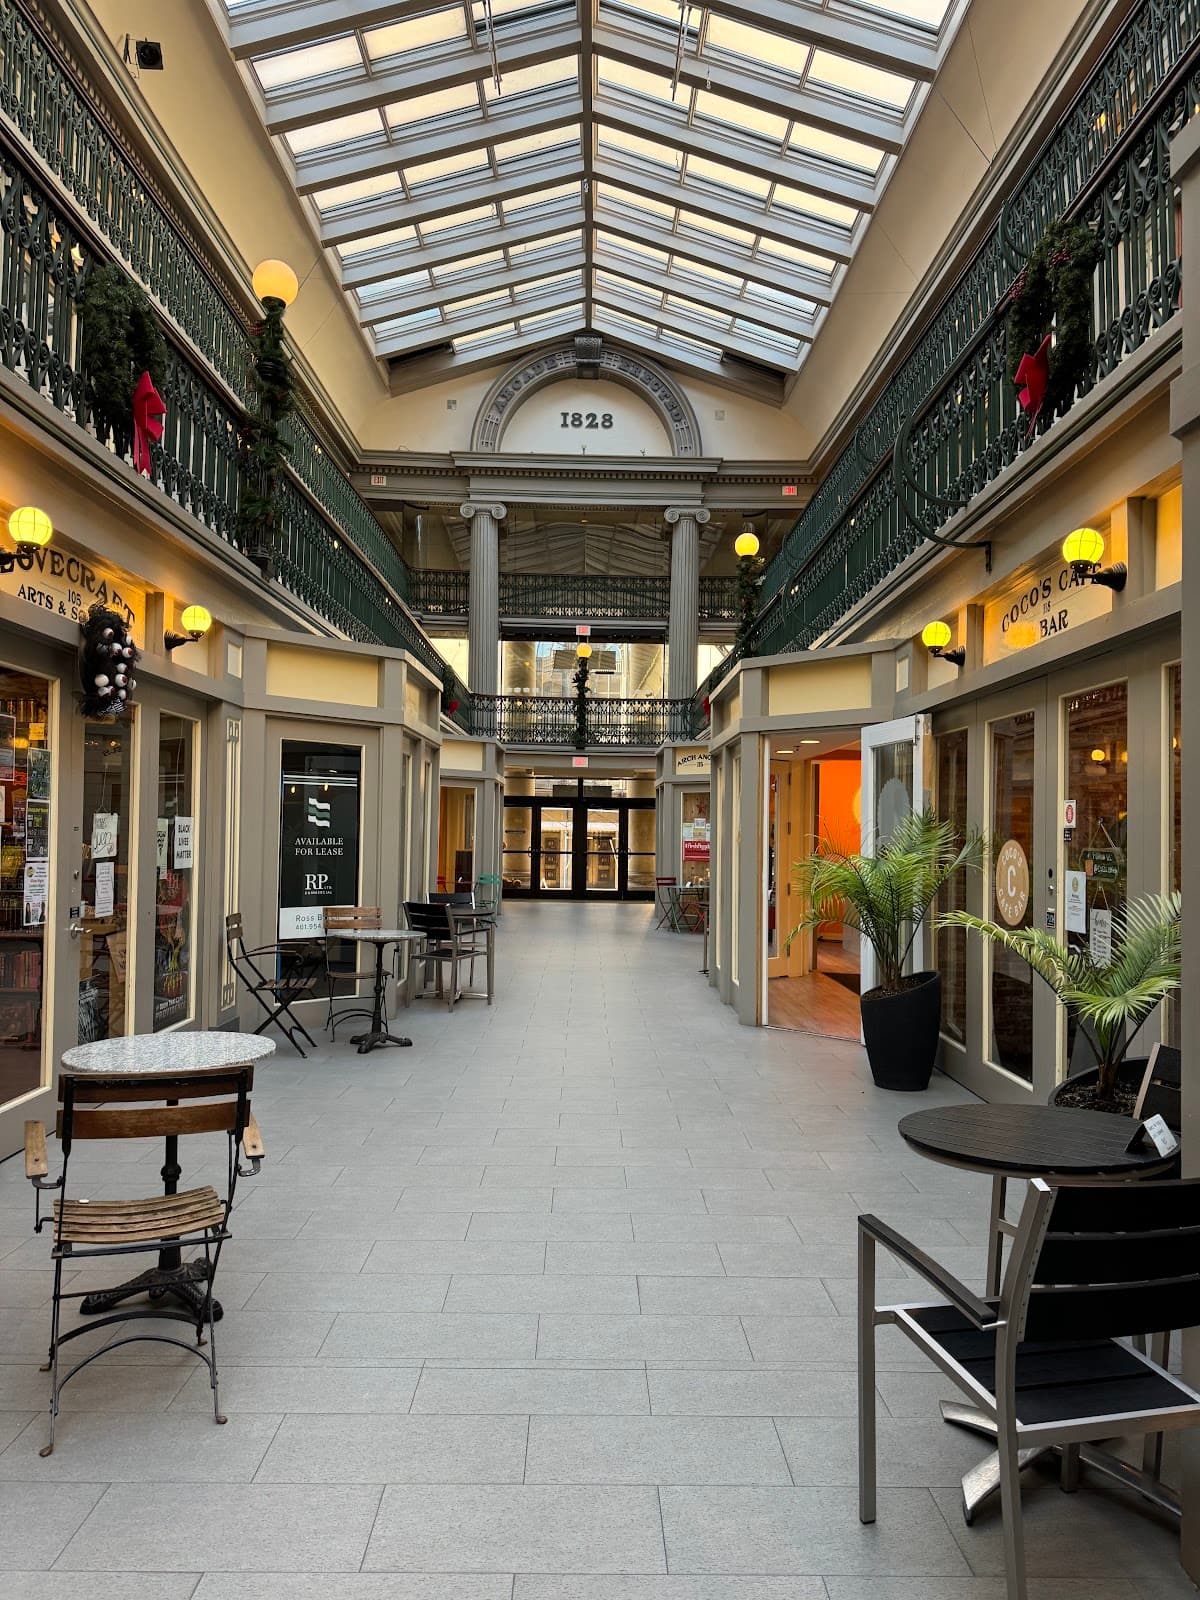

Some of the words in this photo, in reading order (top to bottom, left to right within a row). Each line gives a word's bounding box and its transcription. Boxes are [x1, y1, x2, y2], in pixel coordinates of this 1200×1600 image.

[560, 412, 613, 429] 1828
[18, 583, 54, 610] ARTS
[58, 600, 67, 616] &
[68, 588, 82, 607] 105
[1002, 577, 1052, 632] COCO'S
[1039, 608, 1069, 638] BAR
[295, 837, 343, 846] AVAILABLE
[295, 847, 313, 856] FOR
[315, 847, 343, 856] LEASE
[304, 873, 328, 890] RP
[1007, 865, 1017, 898] C
